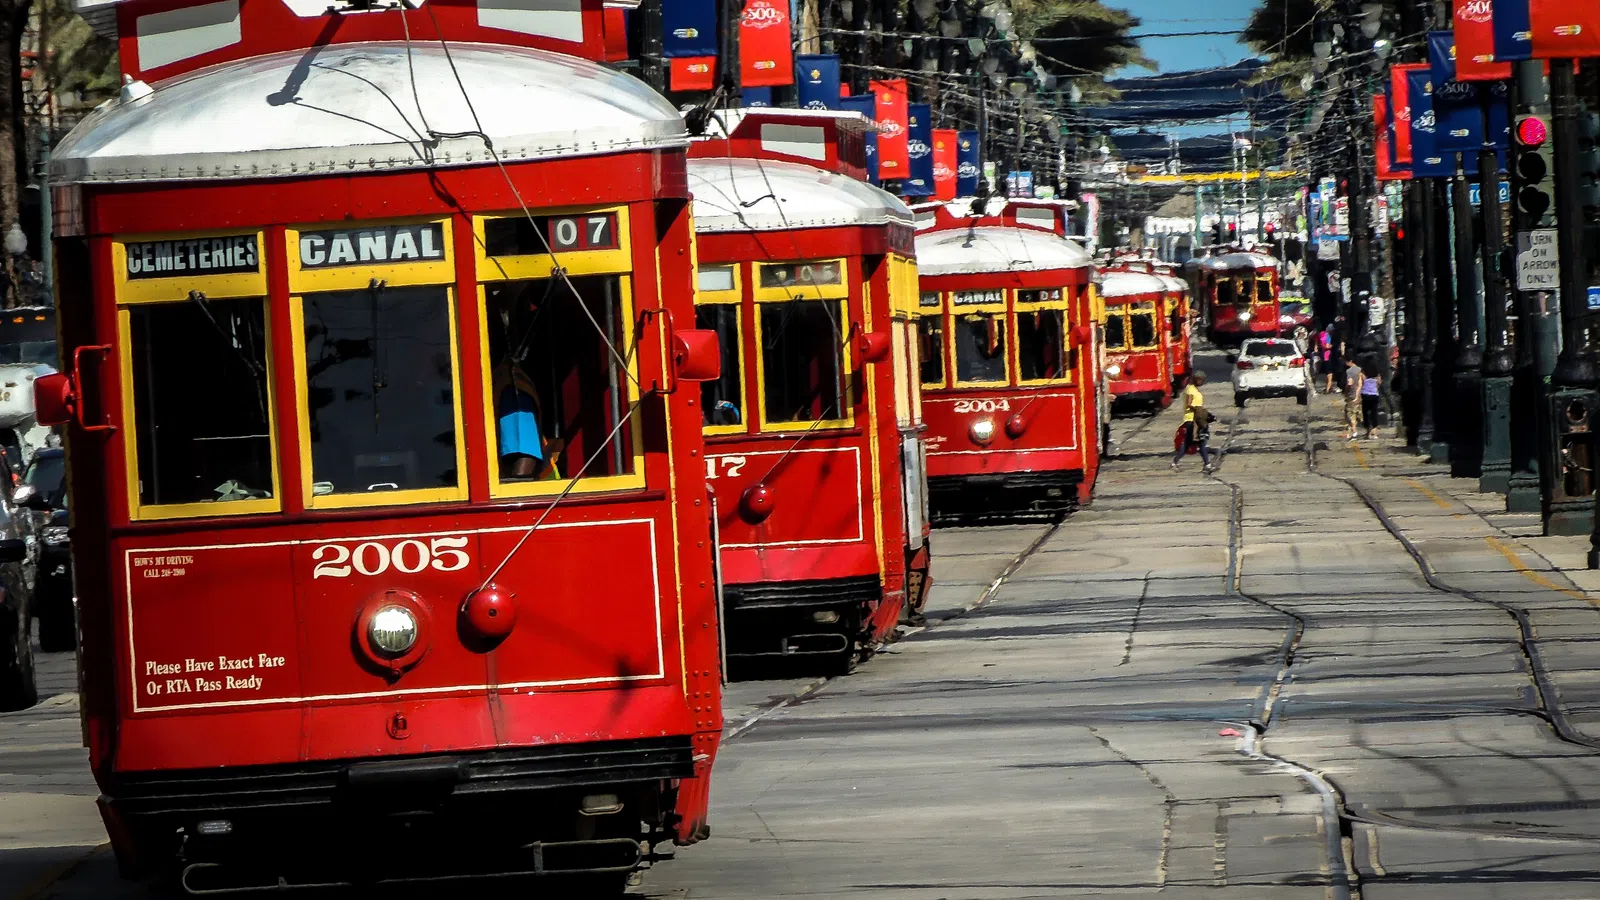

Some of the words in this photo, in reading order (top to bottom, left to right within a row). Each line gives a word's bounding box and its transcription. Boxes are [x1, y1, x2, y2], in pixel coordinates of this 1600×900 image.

[556, 217, 607, 246] 07
[300, 227, 442, 265] CANAL
[1525, 235, 1552, 245] TURN
[128, 236, 259, 274] CEMETERIES
[1531, 248, 1547, 258] ON
[1522, 260, 1557, 271] ARROW
[1526, 274, 1554, 284] ONLY
[954, 293, 1002, 304] CANAL
[953, 399, 1011, 414] 2004
[155, 556, 166, 566] MY
[166, 555, 194, 565] DRIVING
[312, 536, 470, 580] 2005
[143, 568, 161, 578] CALL
[145, 661, 182, 676] Please
[185, 658, 215, 673] Have
[218, 655, 254, 671] Exact
[258, 653, 286, 668] Fare
[146, 680, 163, 696] Or
[166, 679, 192, 694] RTA
[195, 677, 222, 692] Pass
[225, 674, 263, 691] Ready
